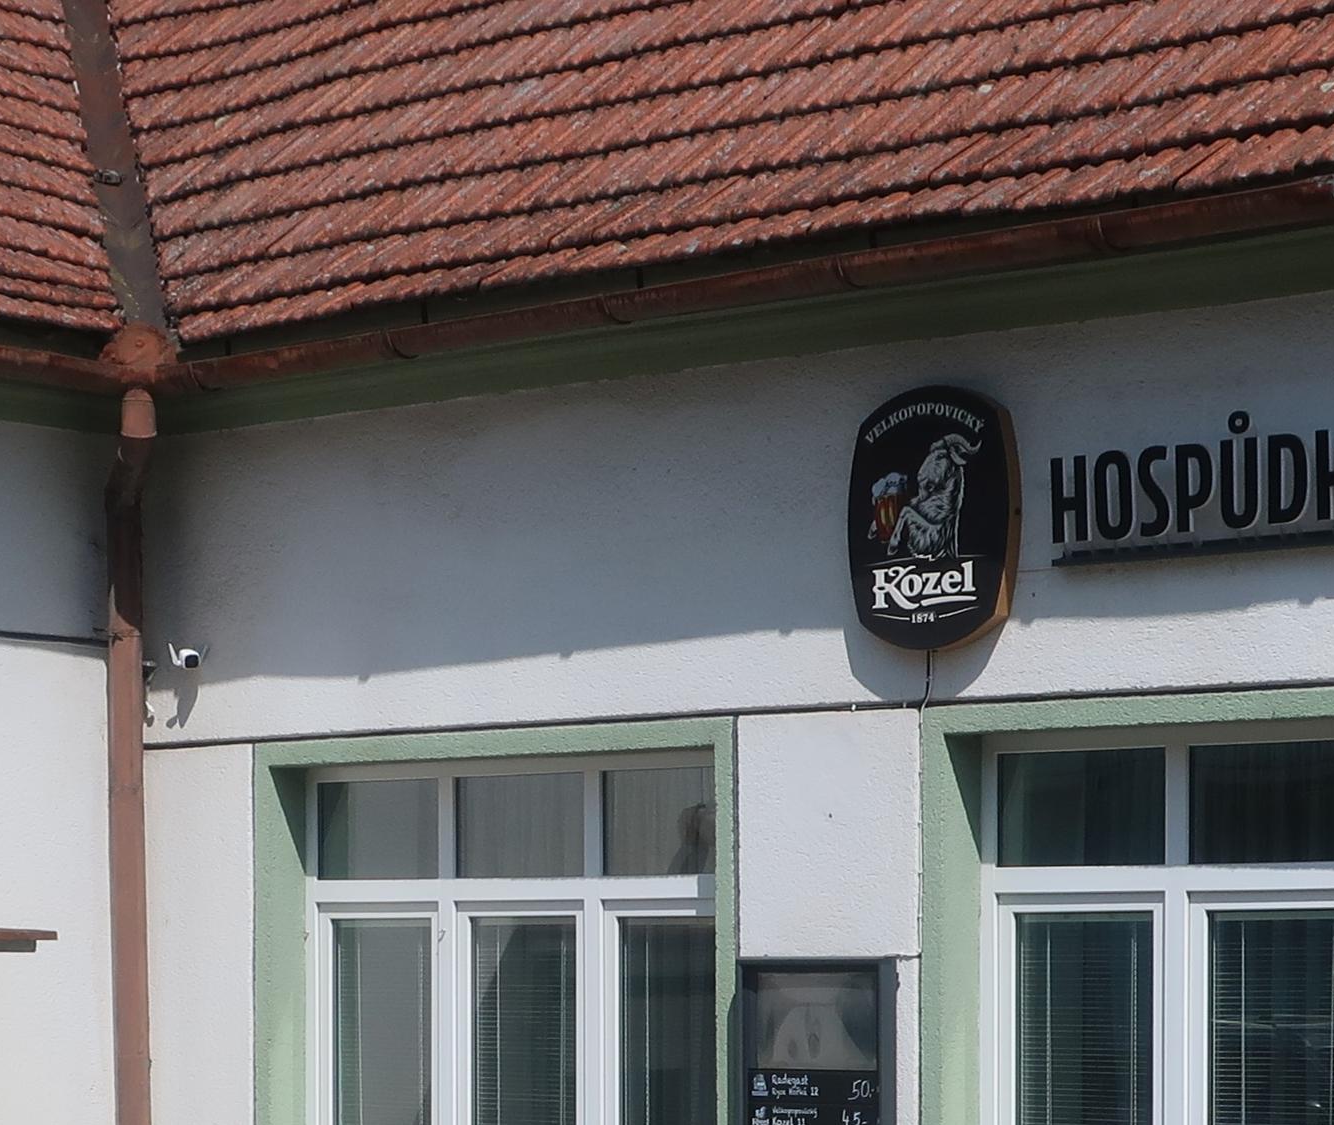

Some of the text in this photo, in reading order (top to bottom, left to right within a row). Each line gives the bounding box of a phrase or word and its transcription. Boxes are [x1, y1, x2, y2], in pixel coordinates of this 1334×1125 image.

[865, 403, 985, 444] VELKOPOPOVICKÝ
[871, 560, 977, 610] Kozel
[911, 612, 935, 624] 1874
[810, 1086, 820, 1097] 12
